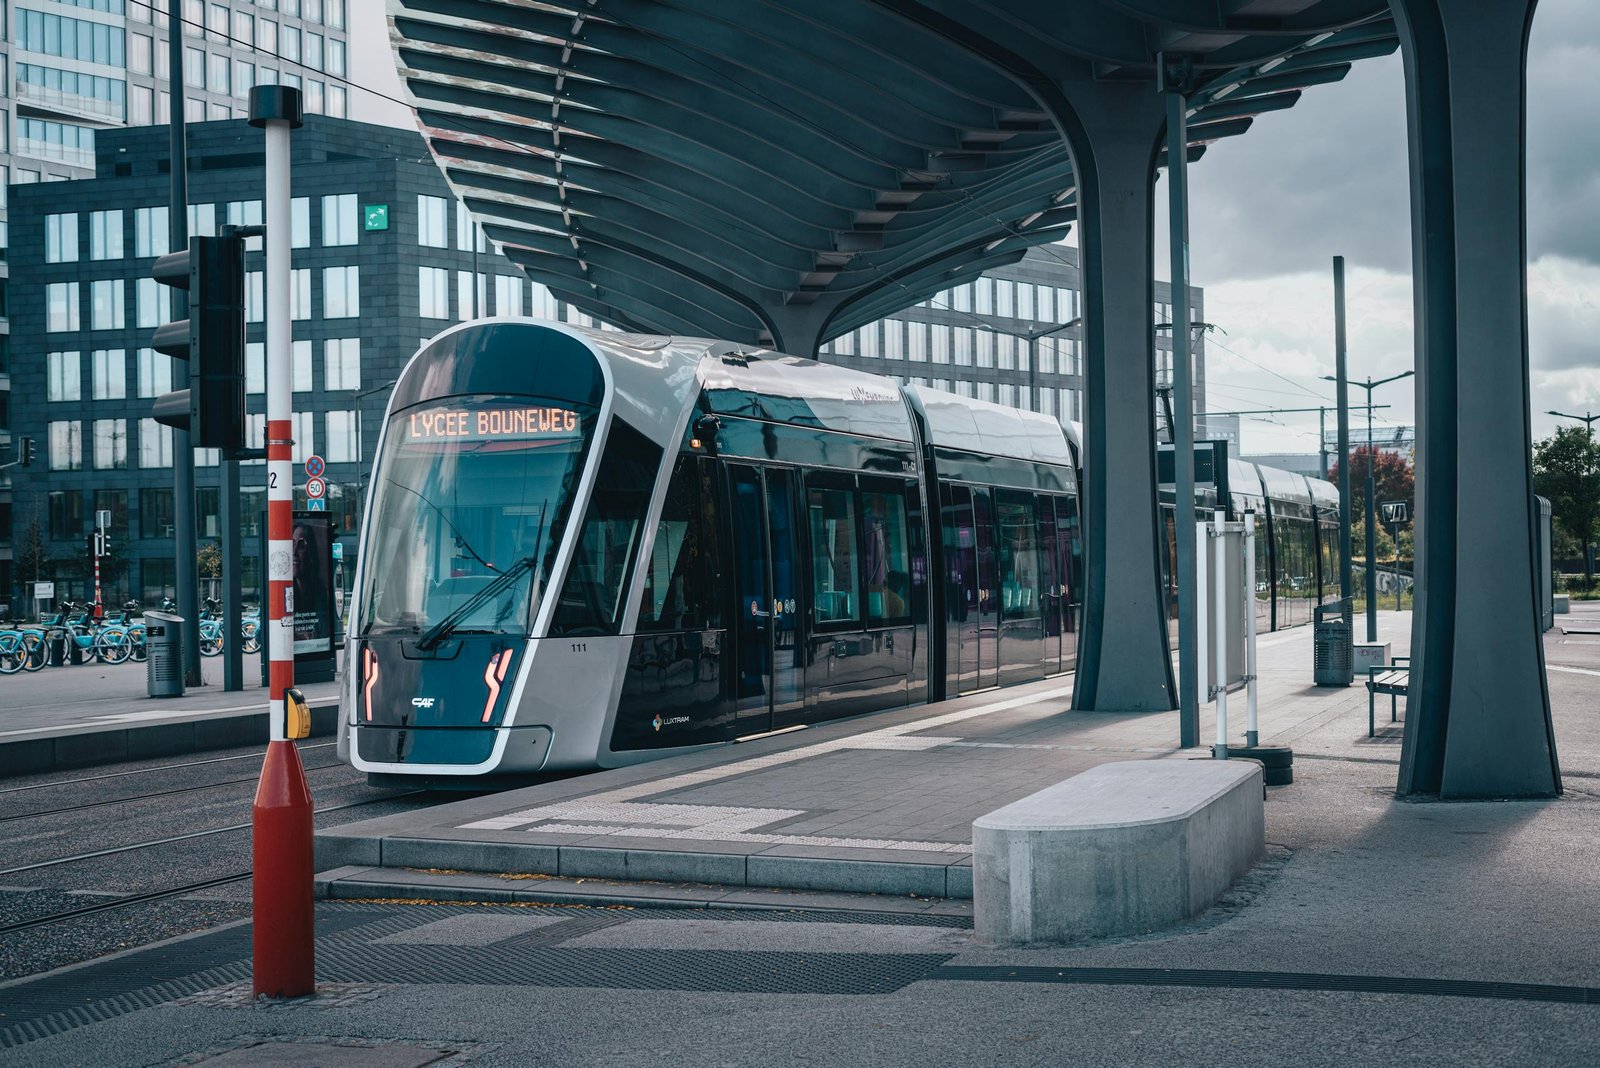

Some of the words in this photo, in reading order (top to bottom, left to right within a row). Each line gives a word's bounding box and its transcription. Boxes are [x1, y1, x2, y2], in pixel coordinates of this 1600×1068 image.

[411, 412, 470, 438] LYCEE
[477, 408, 576, 435] BOUNEWEG
[310, 484, 321, 493] 50
[571, 643, 587, 653] 111
[411, 697, 435, 708] CAF
[663, 715, 690, 725] LUXTRAM
